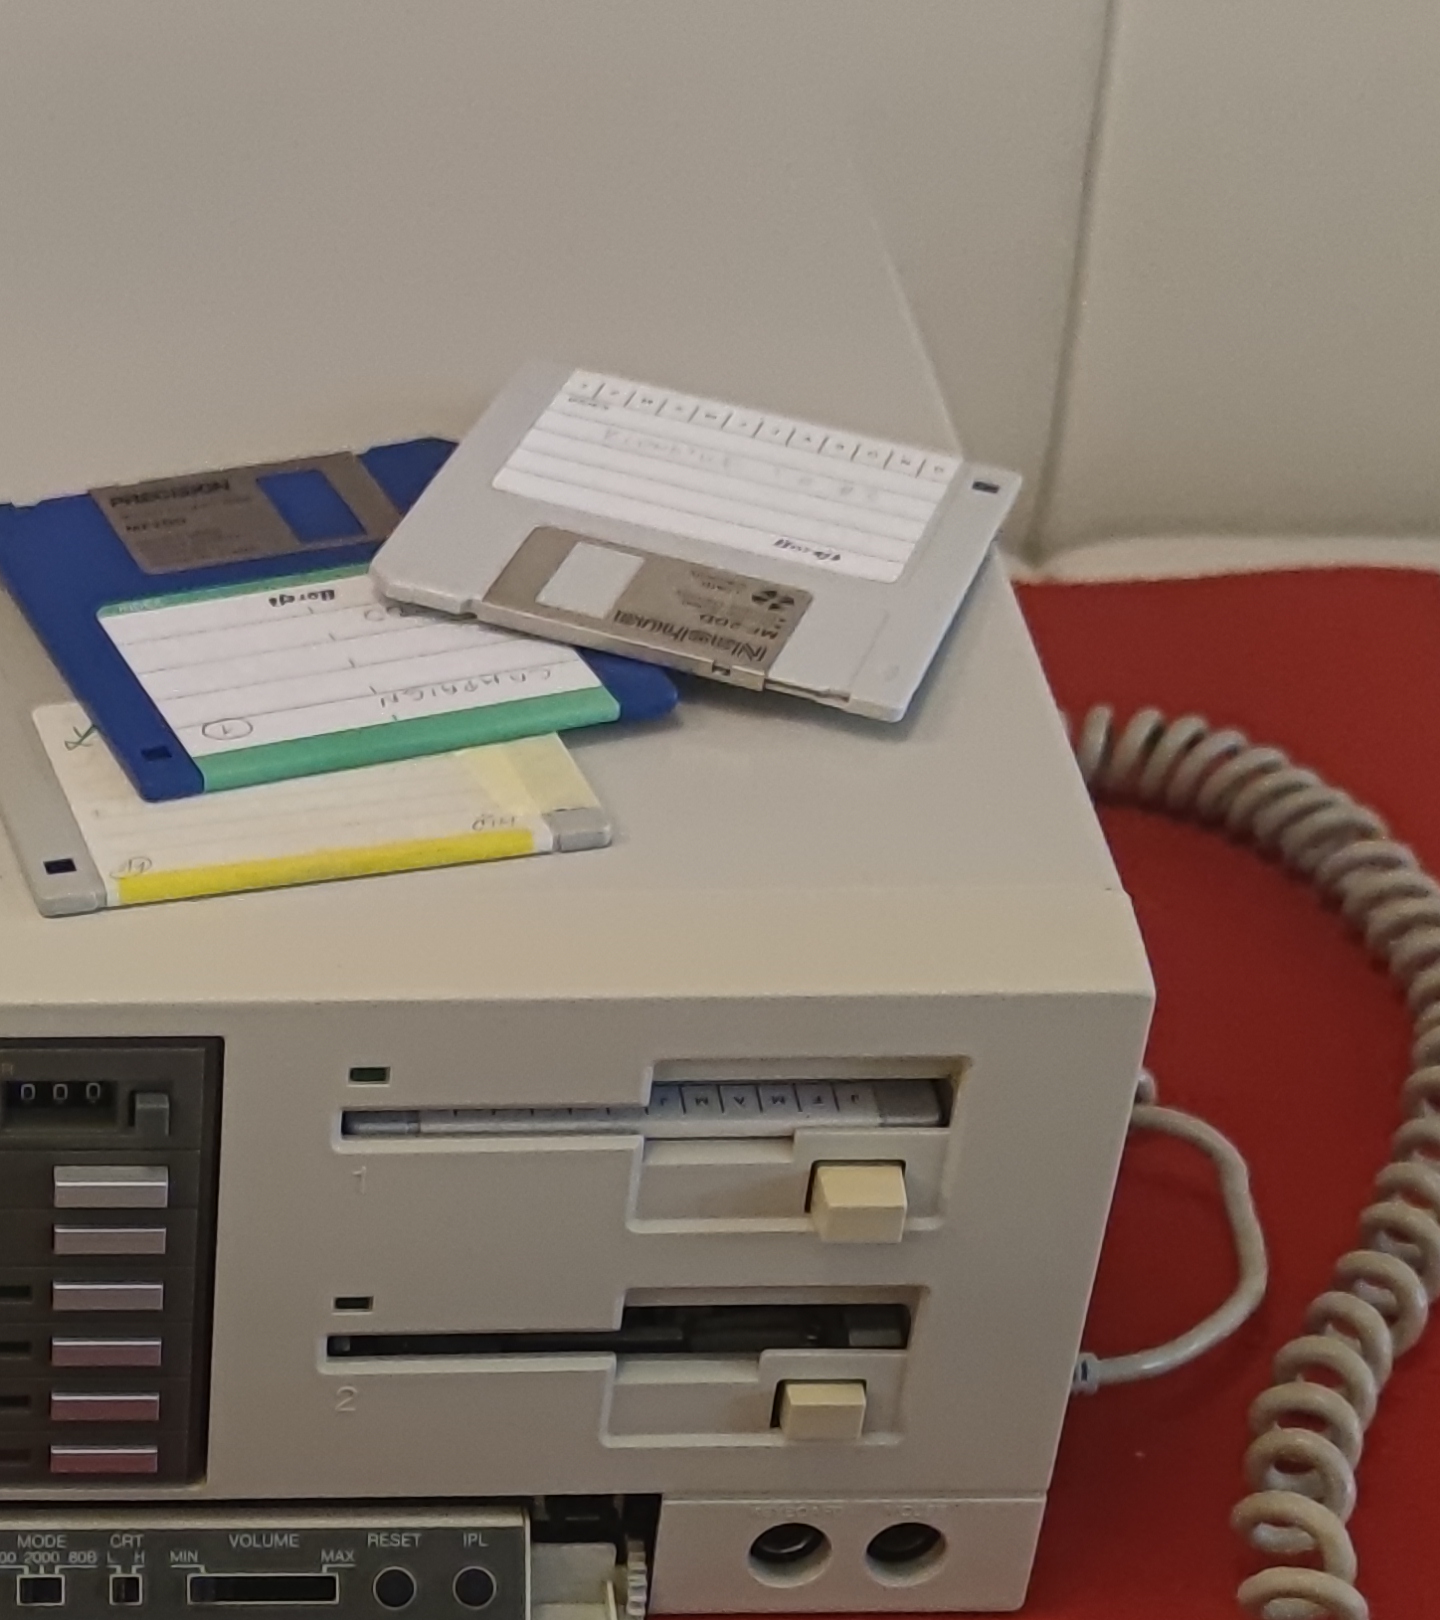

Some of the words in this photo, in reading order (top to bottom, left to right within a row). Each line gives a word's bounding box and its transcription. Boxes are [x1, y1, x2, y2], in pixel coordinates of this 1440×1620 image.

[17, 1533, 67, 1549] MODE
[228, 1532, 299, 1548] VOLUME
[367, 1532, 422, 1548] RESET
[463, 1532, 488, 1548] IPL
[23, 1550, 61, 1564] 2000
[169, 1549, 200, 1564] MIN
[319, 1547, 356, 1563] MAX
